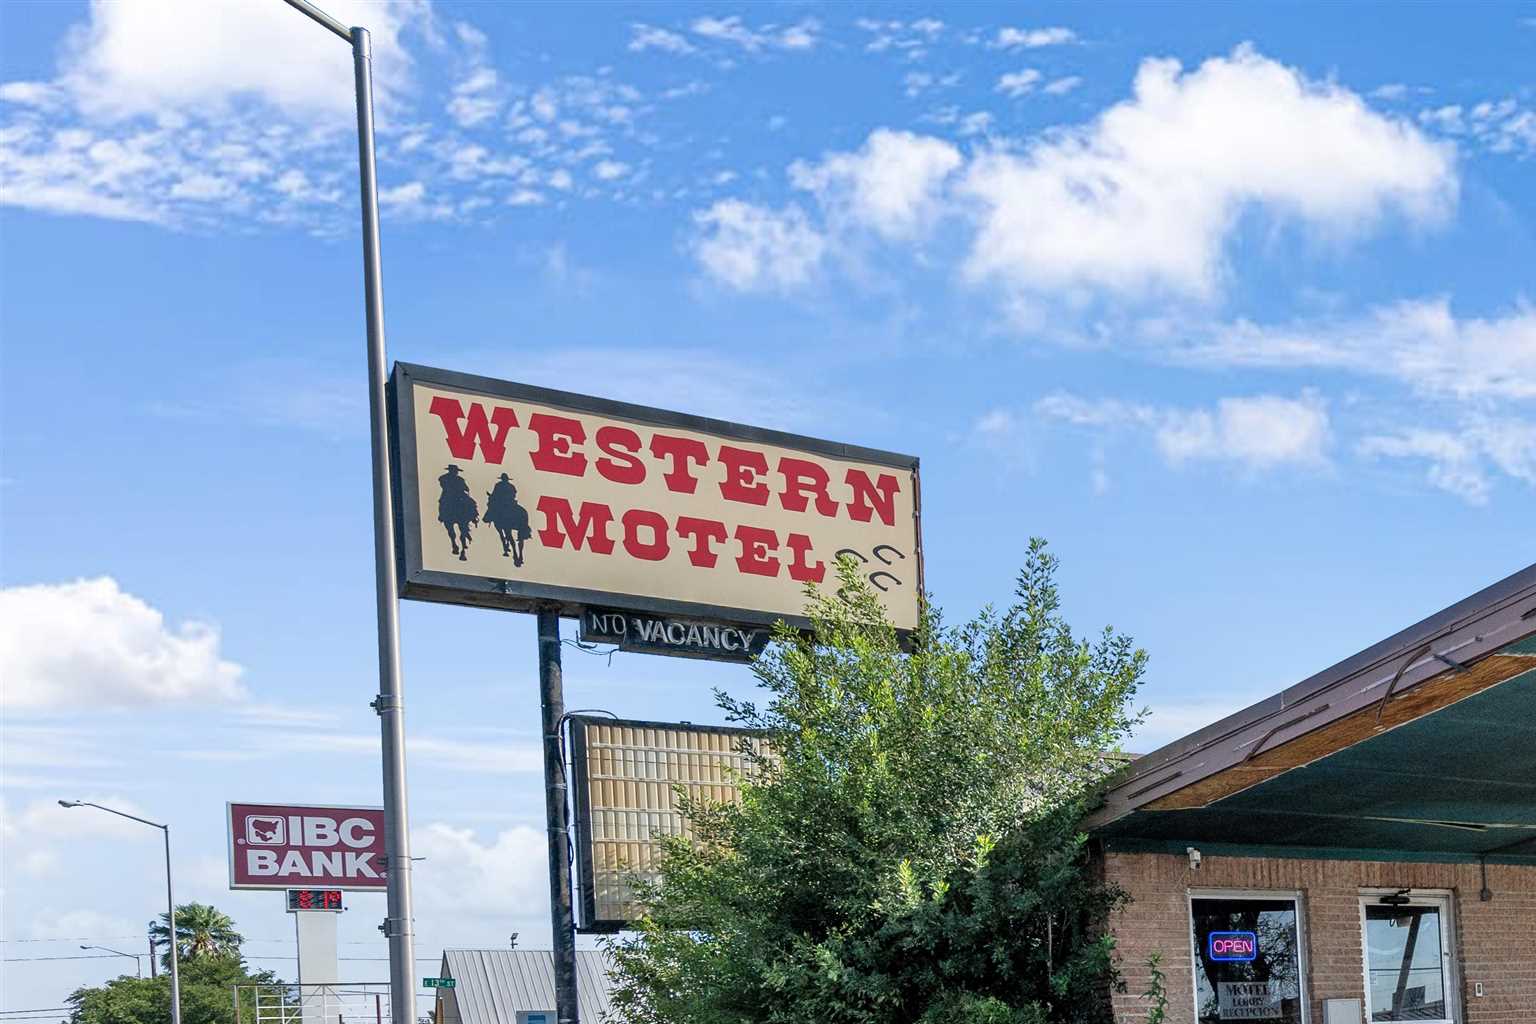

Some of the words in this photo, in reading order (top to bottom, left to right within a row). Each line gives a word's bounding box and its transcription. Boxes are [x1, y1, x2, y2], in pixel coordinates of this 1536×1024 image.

[429, 396, 901, 527] WESTERN
[536, 495, 826, 584] MOTEL
[592, 614, 626, 635] NO
[635, 618, 757, 652] VACANCY
[288, 815, 375, 849] IBC
[246, 849, 379, 879] BANK
[1213, 939, 1253, 953] OPEN
